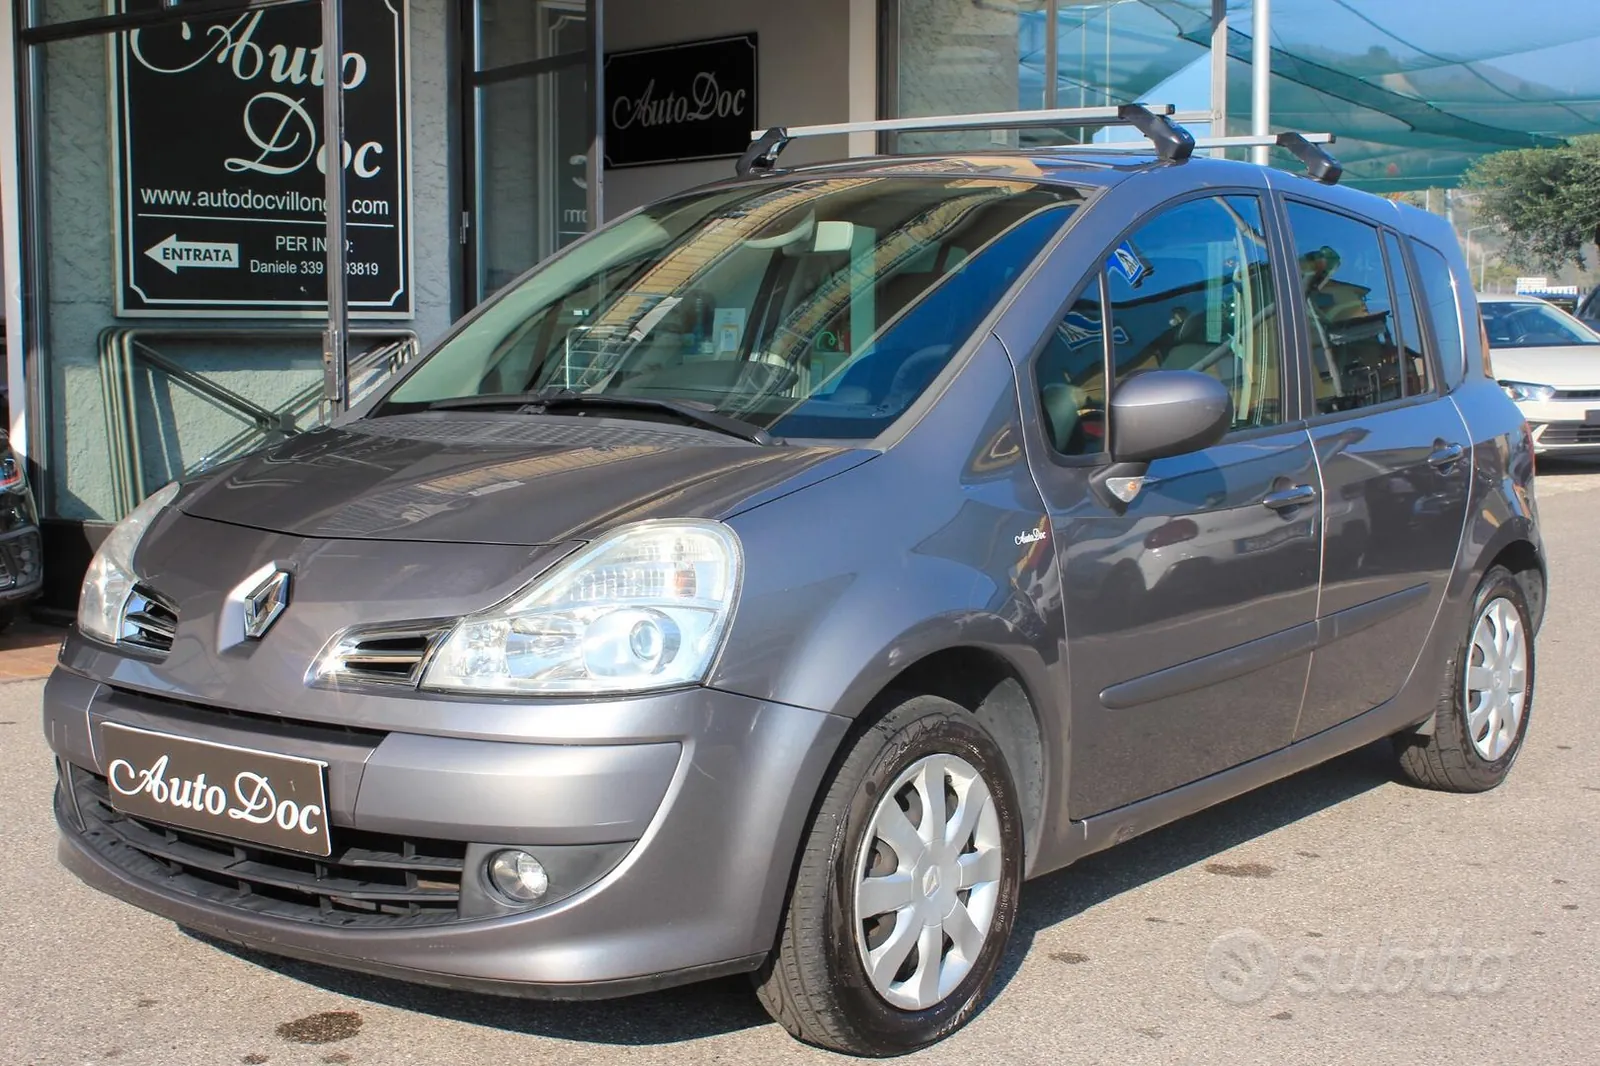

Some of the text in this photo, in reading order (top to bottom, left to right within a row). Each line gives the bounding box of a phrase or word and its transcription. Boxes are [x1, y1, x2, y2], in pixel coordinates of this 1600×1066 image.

[275, 235, 308, 252] PER
[162, 246, 234, 263] ENTRATA
[250, 259, 298, 275] Daniele
[300, 260, 324, 275] 339
